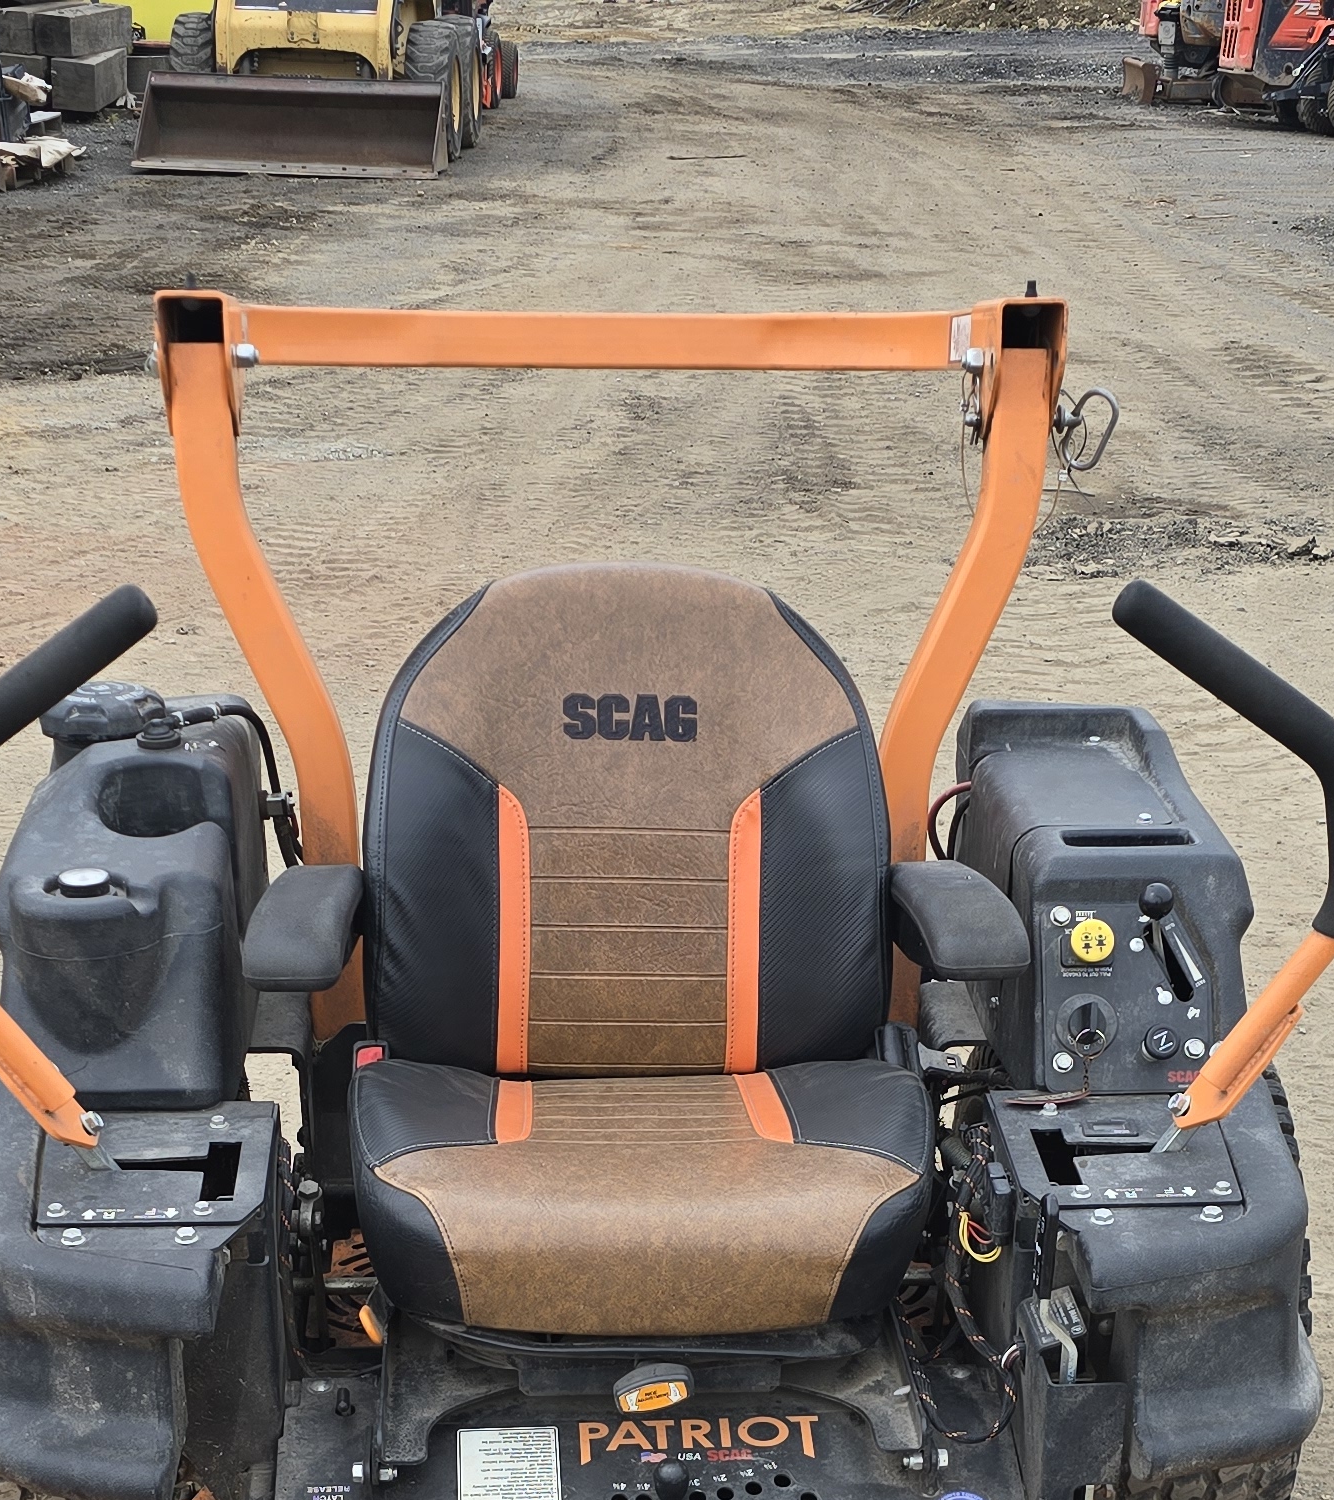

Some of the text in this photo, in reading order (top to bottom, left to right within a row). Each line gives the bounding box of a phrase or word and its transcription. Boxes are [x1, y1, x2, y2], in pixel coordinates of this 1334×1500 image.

[563, 692, 698, 742] SCAG
[578, 1415, 818, 1465] PATRIOT
[678, 1452, 701, 1460] USA
[707, 1449, 753, 1461] SCAG
[307, 1485, 351, 1493] RELEASE
